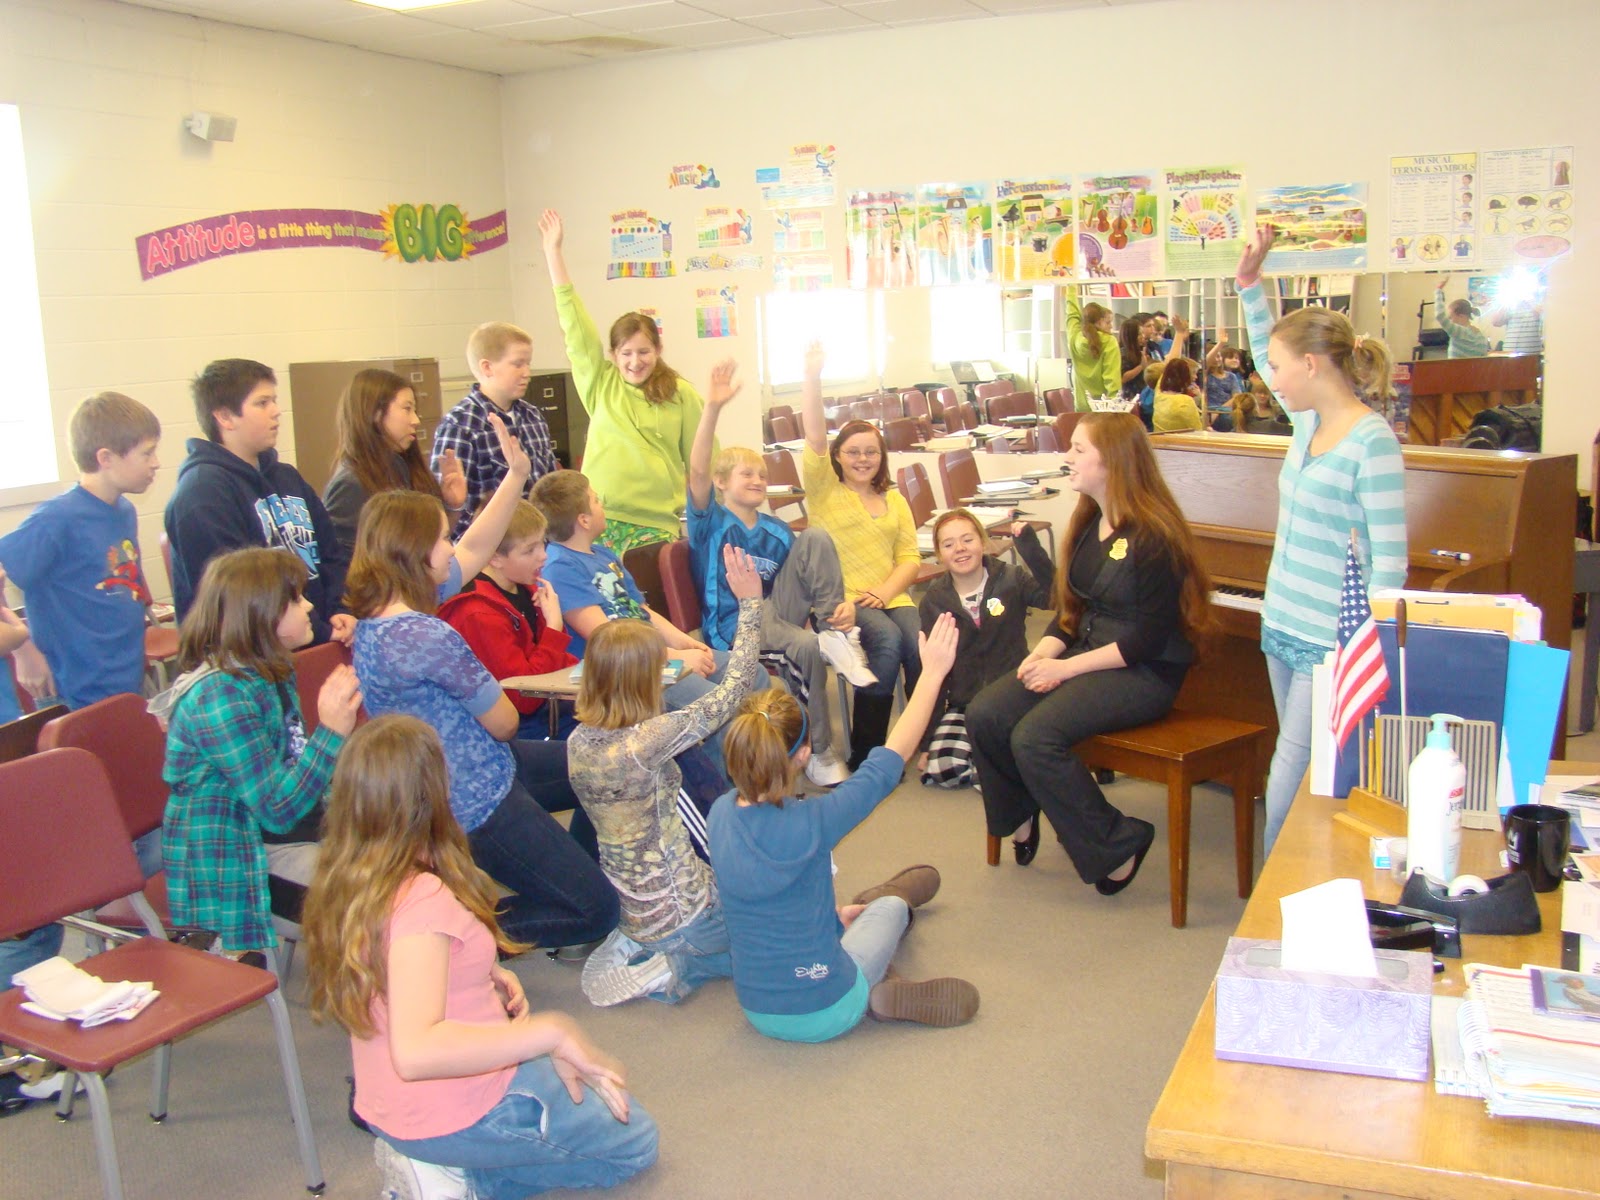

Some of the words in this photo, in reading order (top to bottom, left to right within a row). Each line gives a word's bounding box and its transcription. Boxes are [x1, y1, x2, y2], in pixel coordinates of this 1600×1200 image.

[1413, 155, 1453, 164] MUSICAL
[1393, 165, 1423, 174] TERMS
[1424, 164, 1431, 173] &
[1433, 163, 1475, 173] SYMBOLS
[1166, 172, 1199, 185] Playing
[1200, 169, 1242, 183] Together
[996, 183, 1050, 198] Percussion
[393, 203, 464, 263] BIG
[147, 214, 256, 273] Attitude
[257, 225, 267, 240] is
[268, 226, 277, 240] a
[278, 220, 304, 238] little
[305, 221, 333, 240] thing
[334, 222, 355, 239] that
